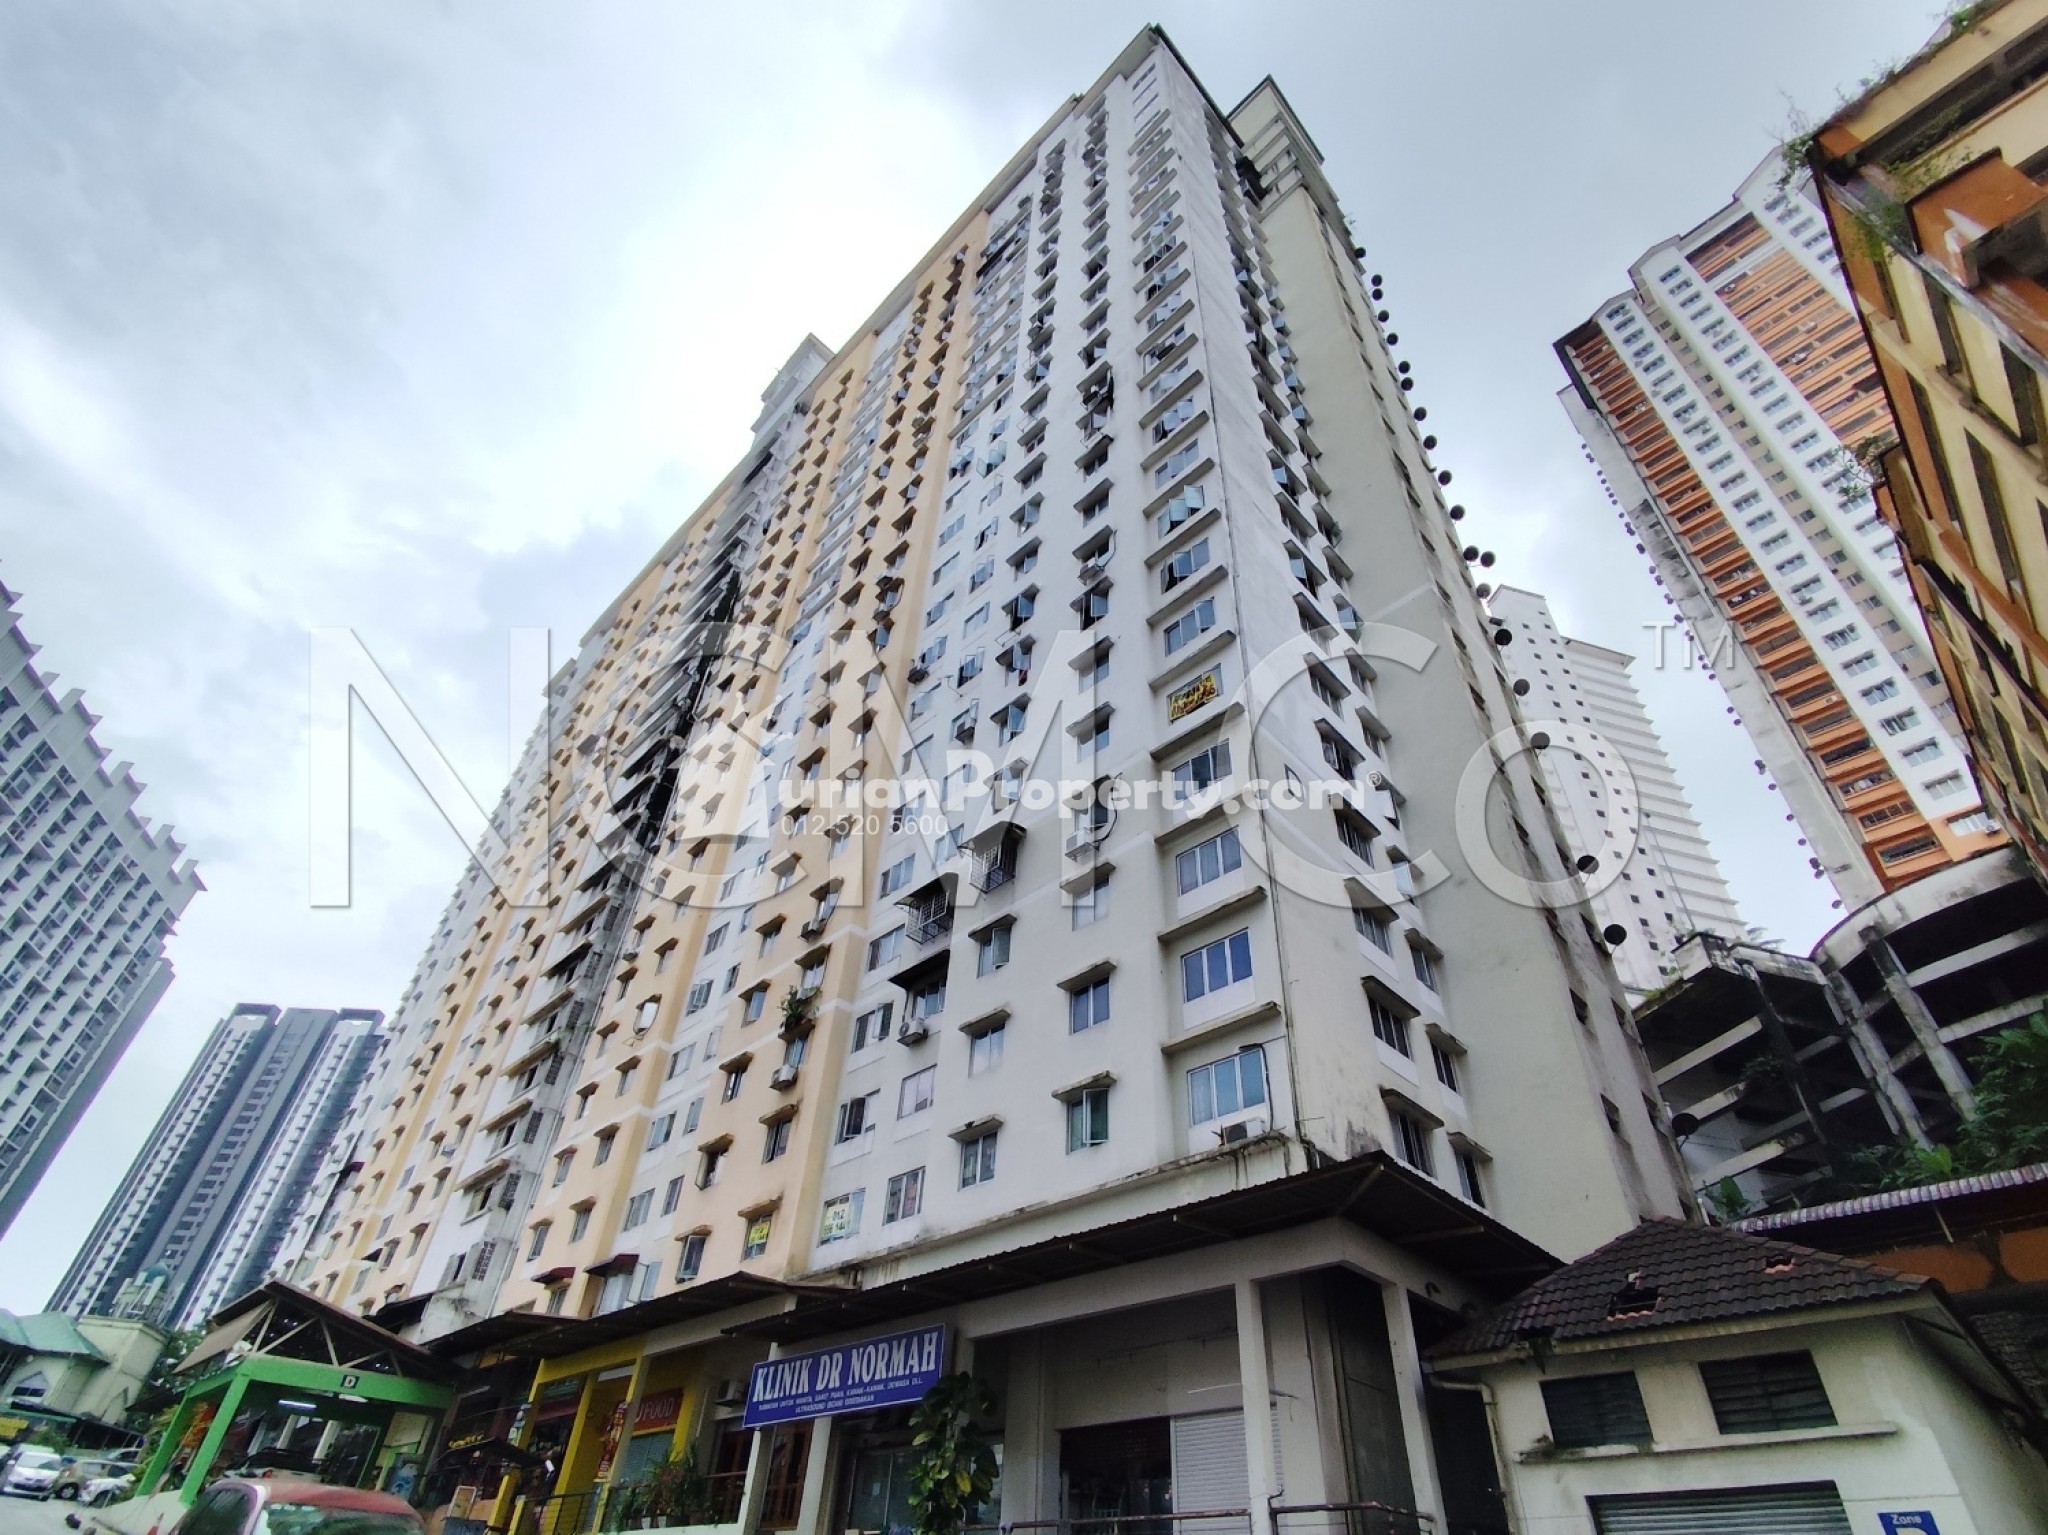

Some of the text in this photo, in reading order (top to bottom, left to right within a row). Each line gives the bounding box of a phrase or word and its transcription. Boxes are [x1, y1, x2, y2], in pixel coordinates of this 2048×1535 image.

[753, 1331, 939, 1403] KLINIK DR NORMAH
[1890, 1513, 1922, 1525] Zone
